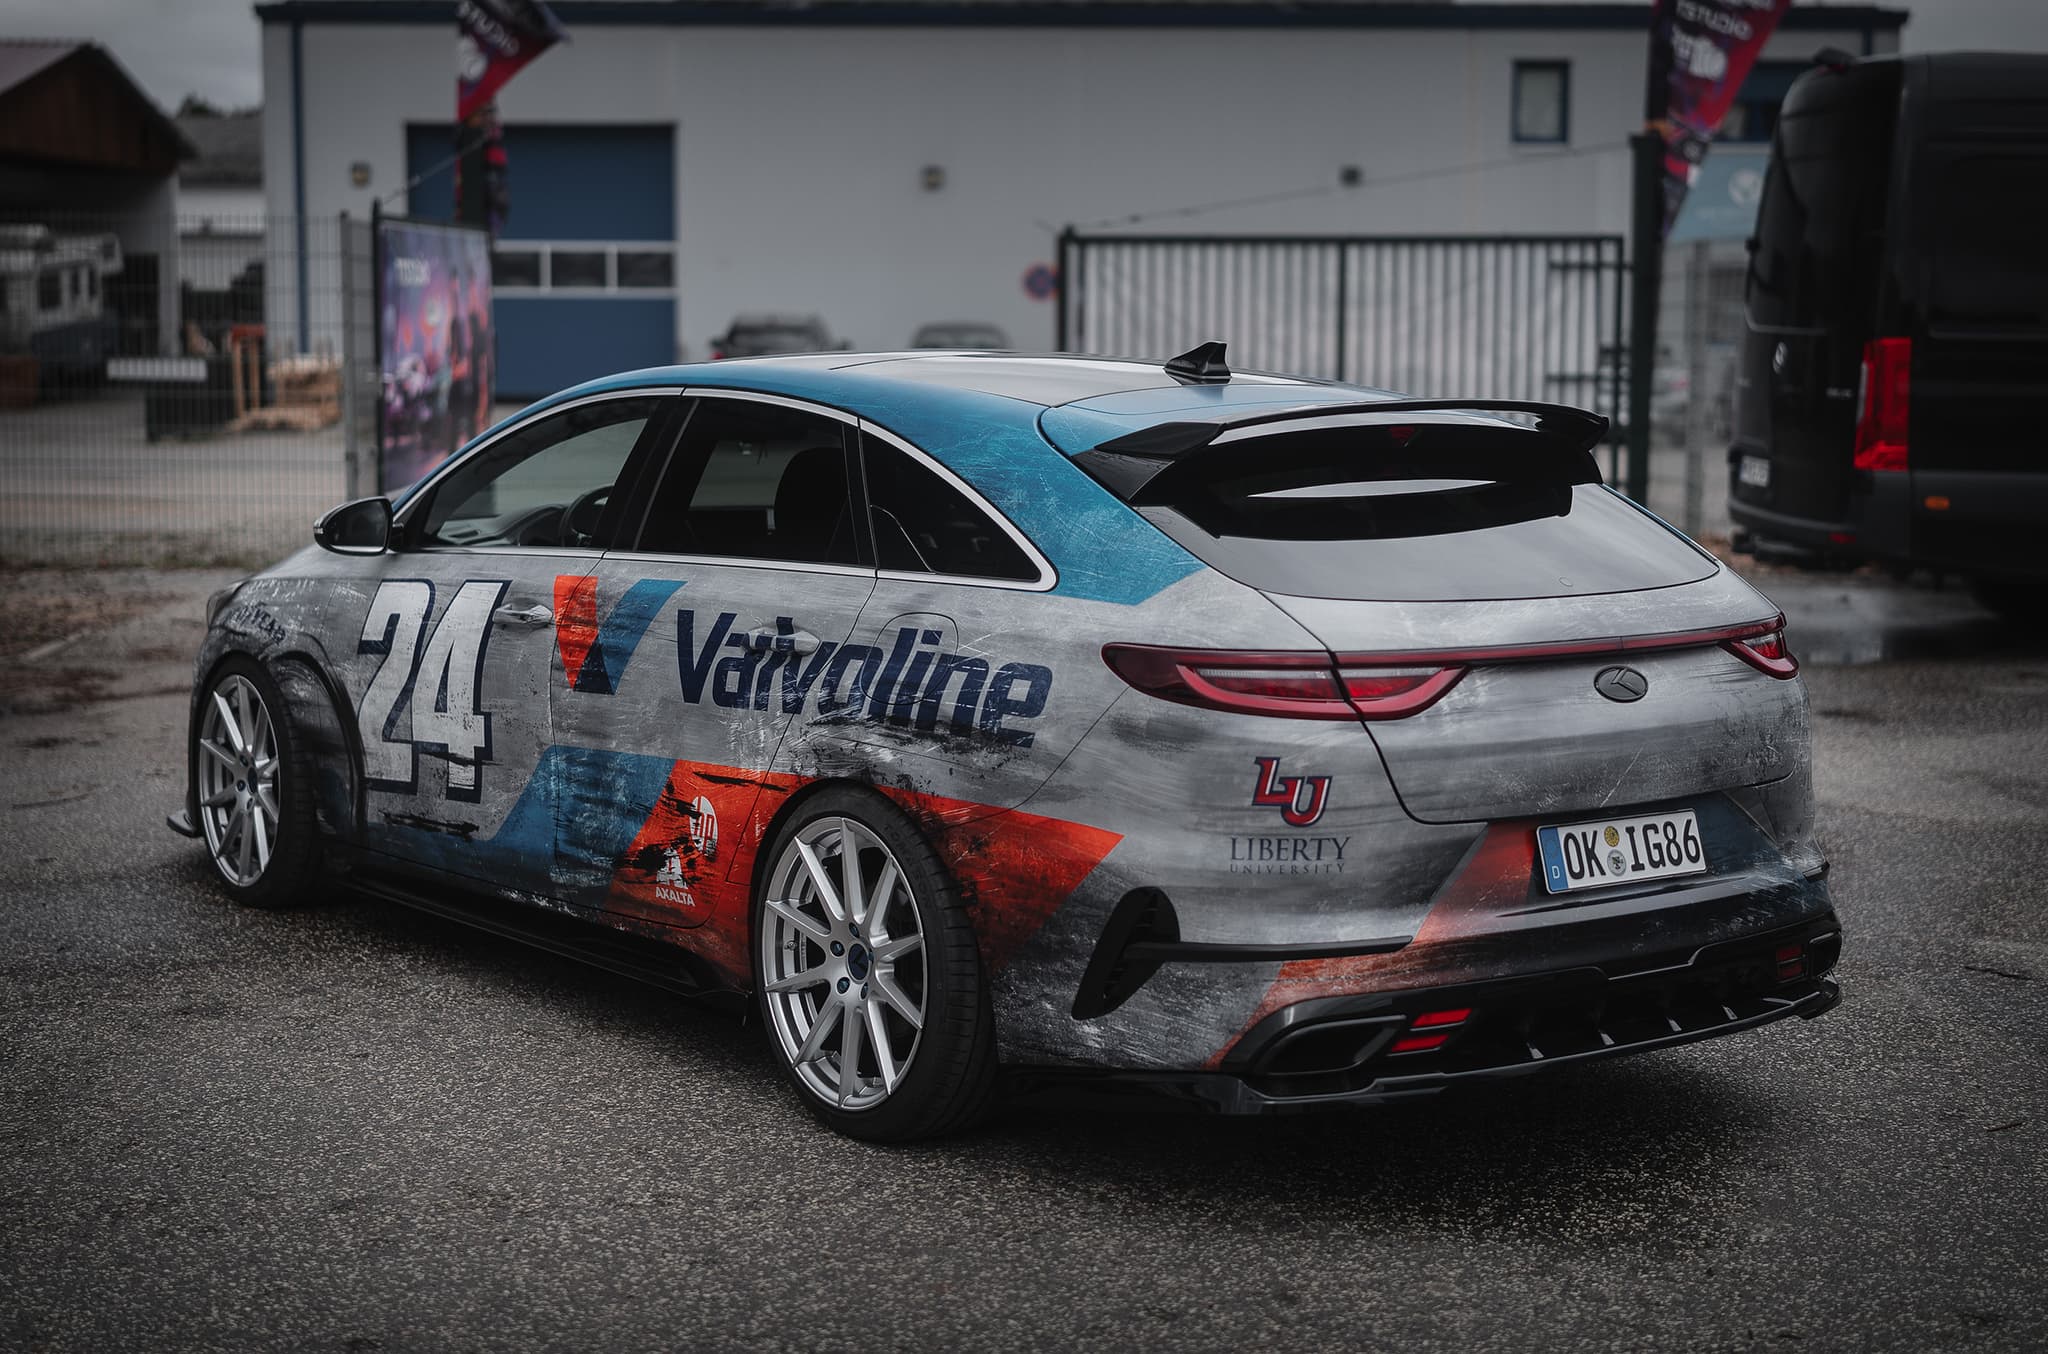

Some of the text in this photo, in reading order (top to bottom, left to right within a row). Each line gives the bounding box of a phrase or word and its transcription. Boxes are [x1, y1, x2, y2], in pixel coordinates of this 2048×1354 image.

[357, 578, 513, 804] 24
[677, 609, 1053, 748] Valvoline
[1251, 756, 1333, 828] LU
[1230, 863, 1345, 874] UNIVERSITY
[1231, 837, 1351, 861] LIBERTY
[1563, 819, 1700, 880] OK IG86
[1552, 865, 1561, 880] D
[655, 887, 696, 907] AXALTA
